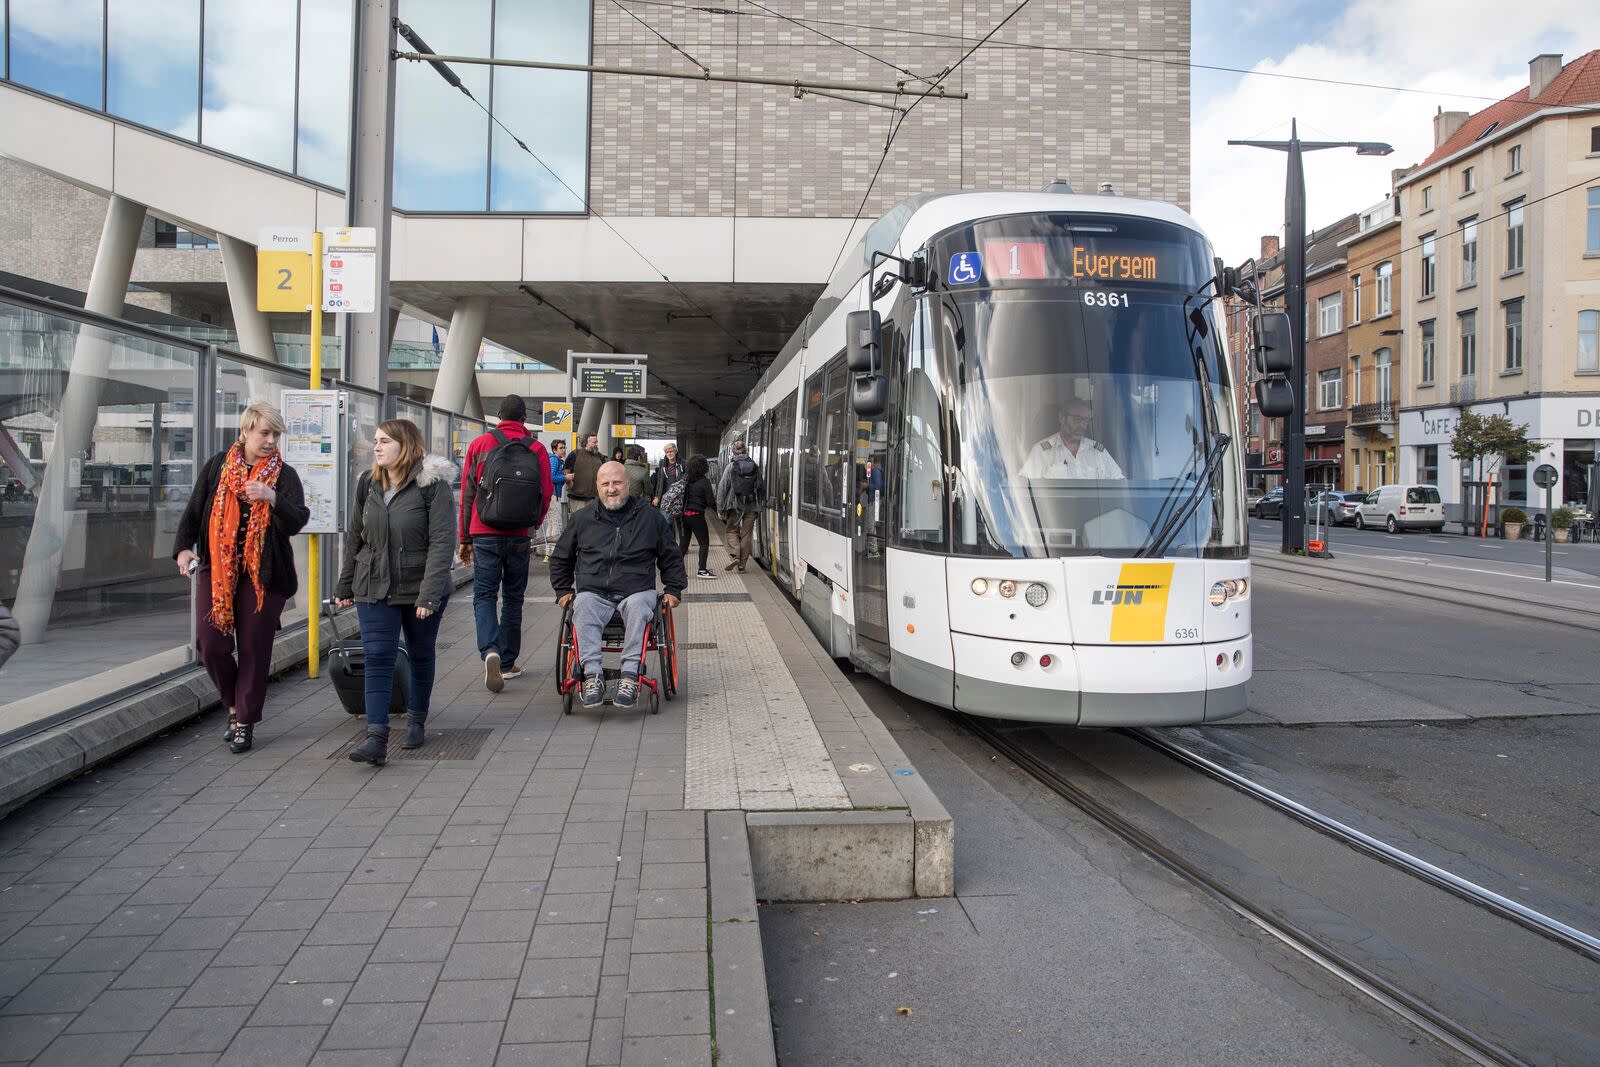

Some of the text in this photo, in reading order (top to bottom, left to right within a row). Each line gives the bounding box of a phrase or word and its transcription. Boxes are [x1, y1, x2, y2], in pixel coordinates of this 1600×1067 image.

[1008, 245, 1021, 275] 1
[1073, 247, 1156, 279] Evergem
[277, 268, 292, 290] 2
[1084, 291, 1129, 308] 6361
[1424, 418, 1450, 435] CAFE
[1175, 628, 1198, 639] 6361
